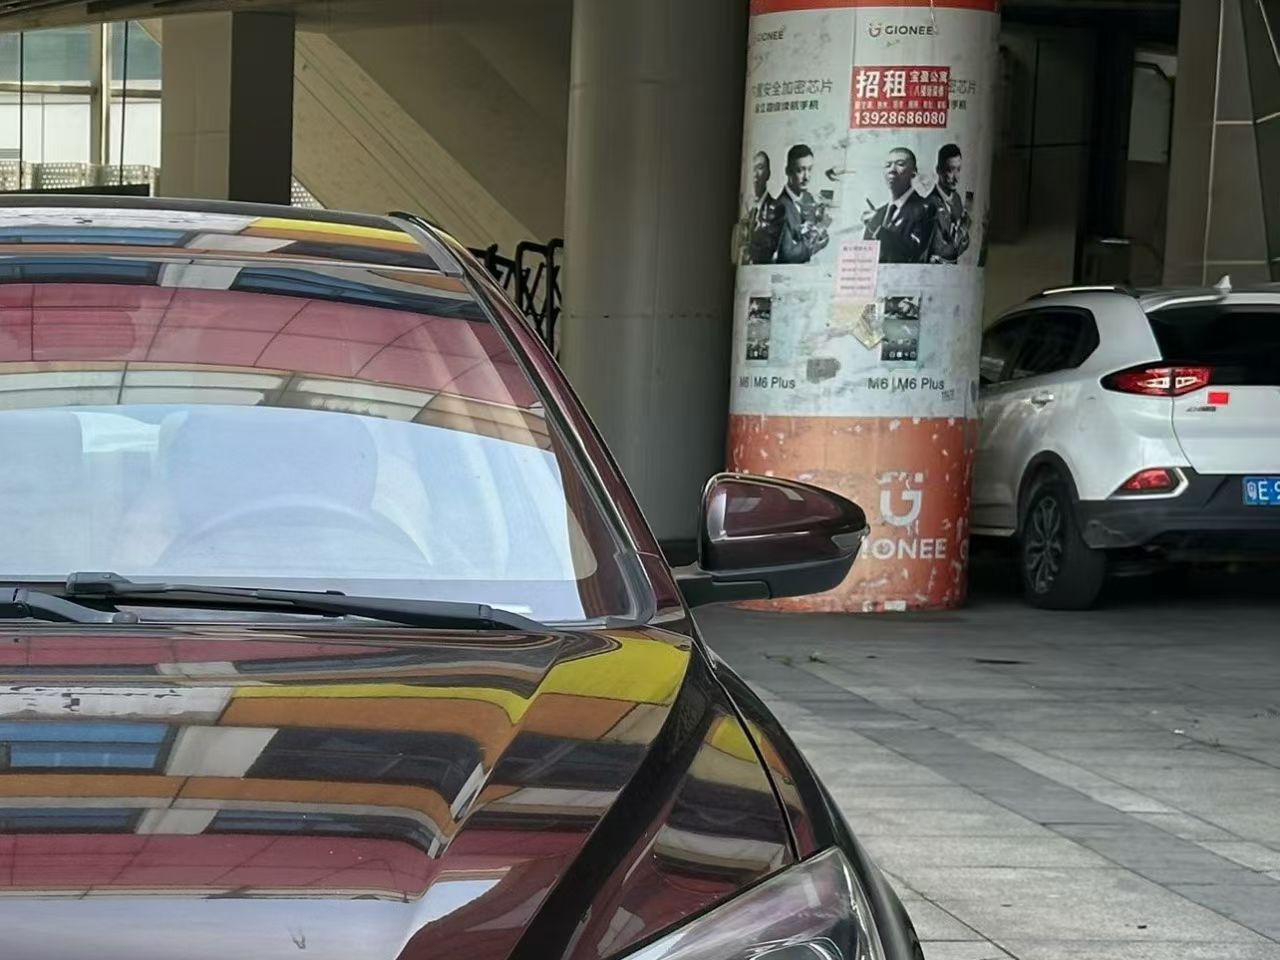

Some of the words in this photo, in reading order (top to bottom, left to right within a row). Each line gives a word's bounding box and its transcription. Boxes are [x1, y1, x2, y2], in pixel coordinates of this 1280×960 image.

[885, 25, 934, 35] GIONEE
[856, 70, 906, 98] 招租
[854, 111, 946, 125] 13928686080
[754, 376, 768, 389] M6
[771, 376, 796, 389] Plus
[867, 377, 889, 390] M6
[897, 377, 917, 391] M6
[921, 377, 945, 390] Plus
[861, 538, 947, 560] IONEE
